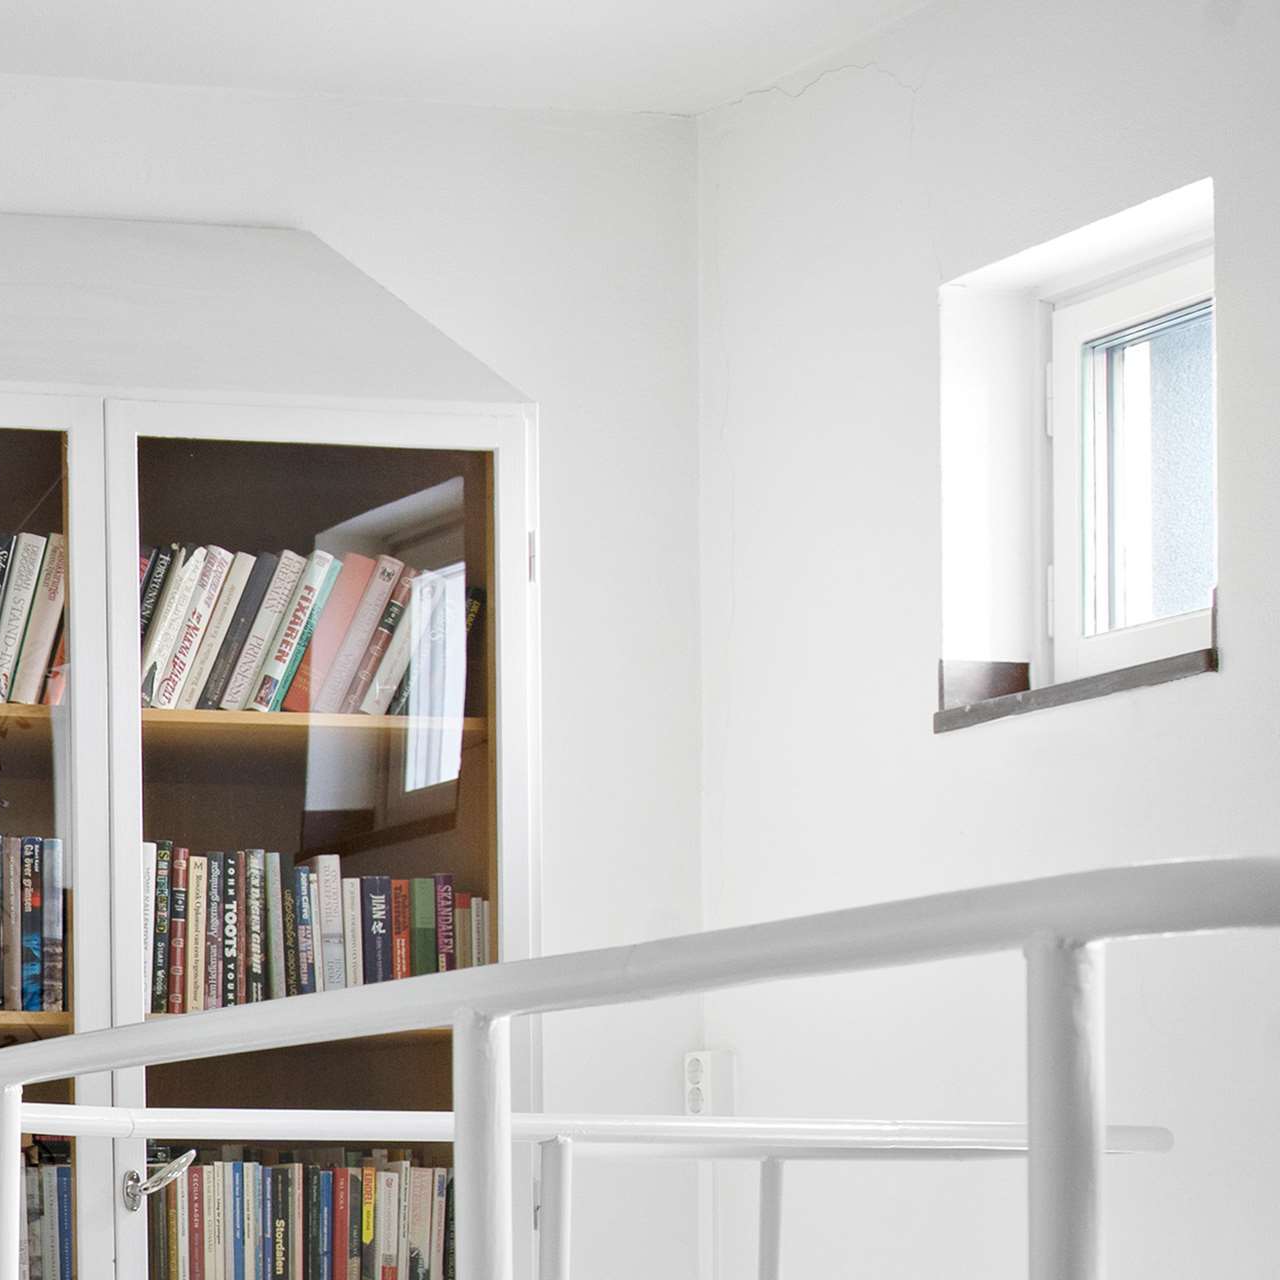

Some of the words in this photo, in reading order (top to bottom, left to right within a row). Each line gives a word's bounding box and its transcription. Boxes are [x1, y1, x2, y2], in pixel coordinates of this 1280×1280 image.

[0, 596, 25, 671] STAND-IN
[274, 585, 317, 664] FIXAREN
[225, 635, 265, 704] PRINSESSA
[24, 858, 33, 877] över
[301, 872, 310, 895] John
[225, 900, 237, 958] TOOTS
[302, 896, 310, 919] Clive
[370, 894, 387, 919] JIAN
[437, 885, 454, 954] SKANDALEN
[275, 1219, 286, 1275] Stordalen
